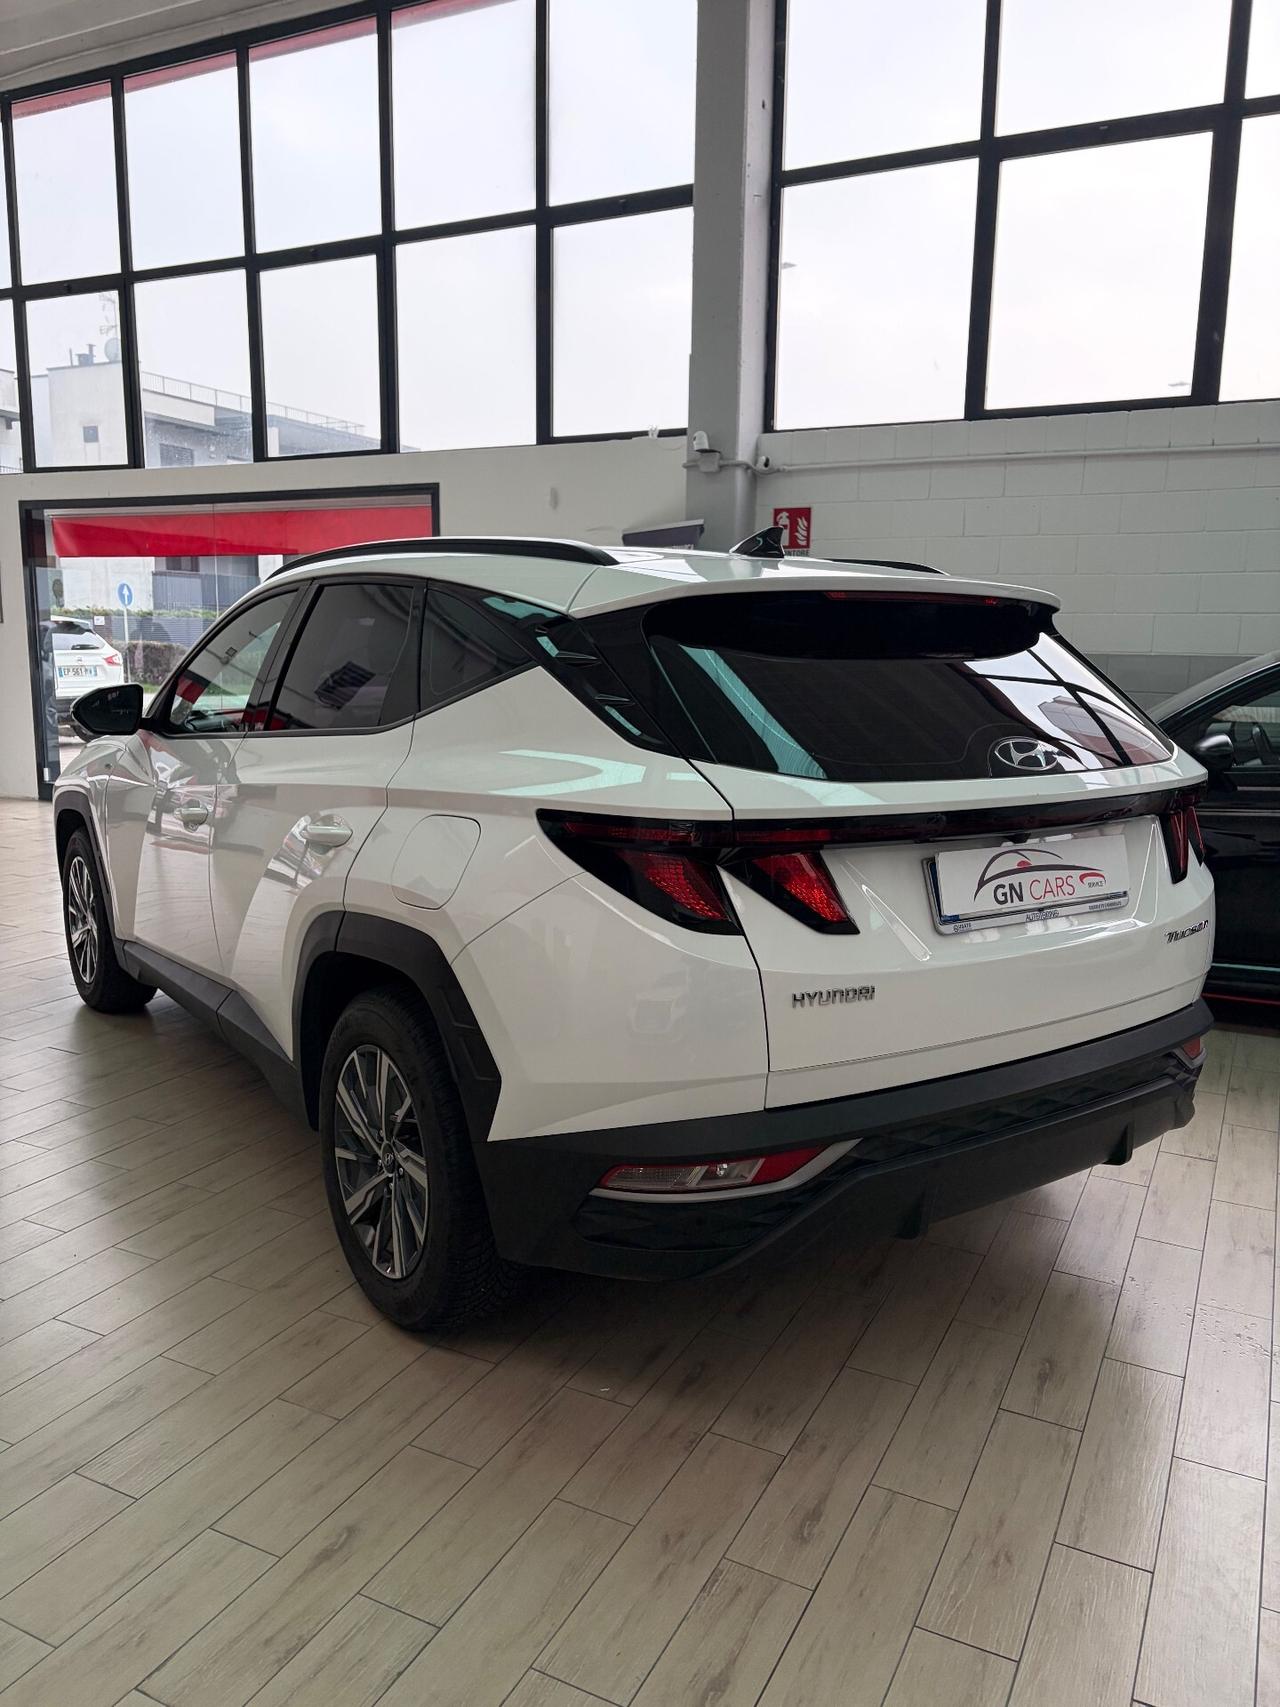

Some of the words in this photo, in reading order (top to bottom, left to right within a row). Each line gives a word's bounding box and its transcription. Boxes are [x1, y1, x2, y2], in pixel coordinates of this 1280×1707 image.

[993, 882, 1023, 905] GN
[1029, 876, 1075, 901] CARS
[791, 986, 876, 1009] HYUNDAI
